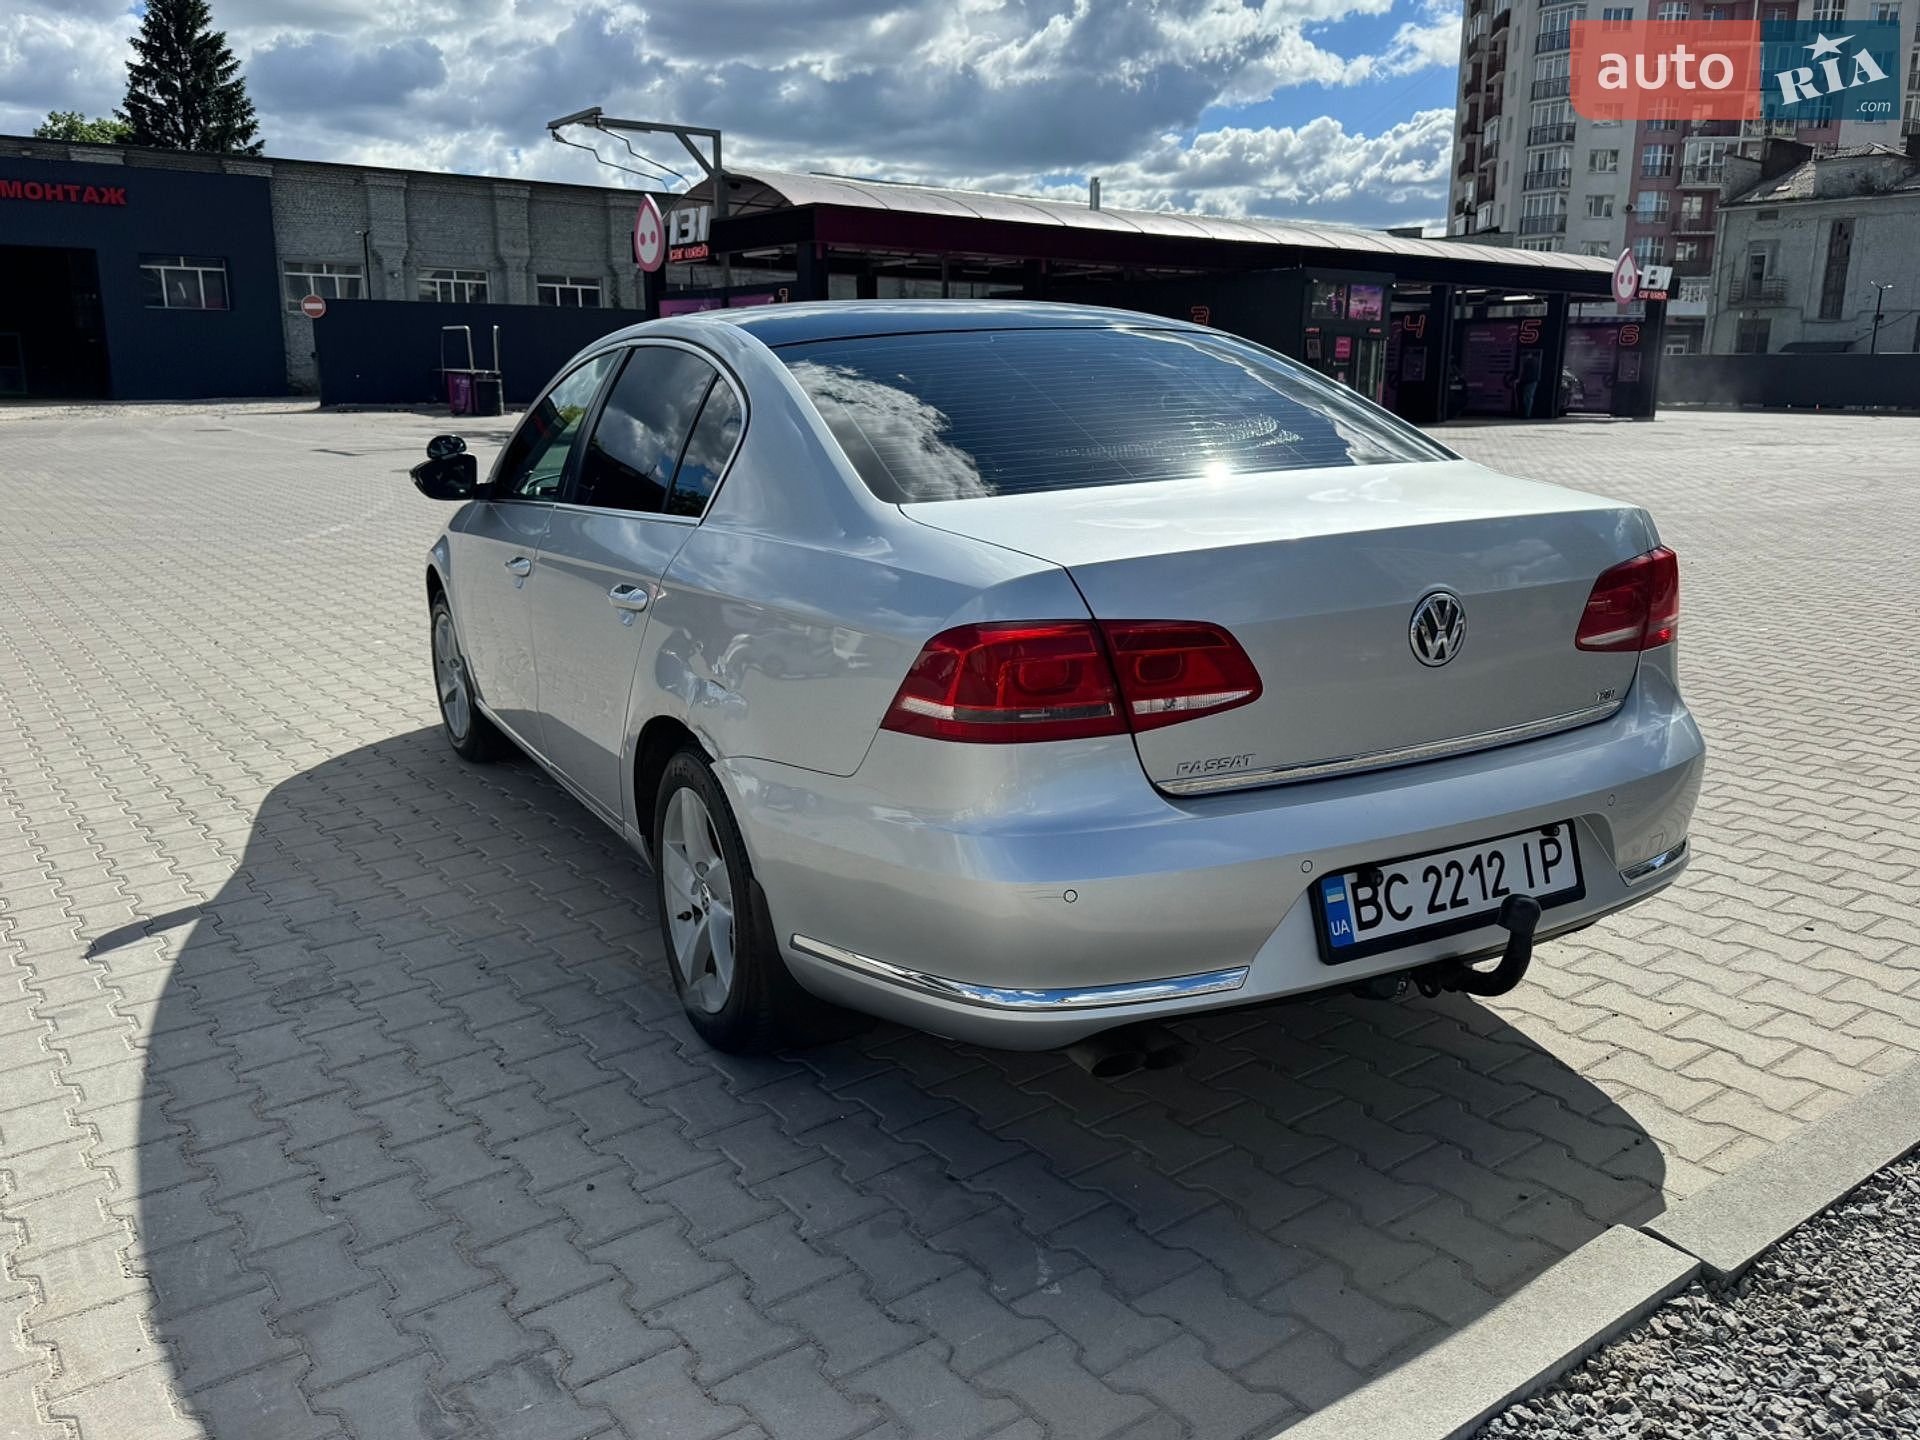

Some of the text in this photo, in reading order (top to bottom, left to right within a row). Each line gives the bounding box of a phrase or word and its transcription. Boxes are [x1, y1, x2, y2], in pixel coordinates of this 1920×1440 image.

[0, 181, 127, 205] МОНТАЖ
[1404, 315, 1425, 338] 4
[1519, 319, 1542, 343] 5
[1619, 325, 1639, 345] 6
[1176, 753, 1256, 776] PASSAT
[1350, 838, 1563, 932] BC 2212 IP
[1330, 919, 1351, 937] UA
